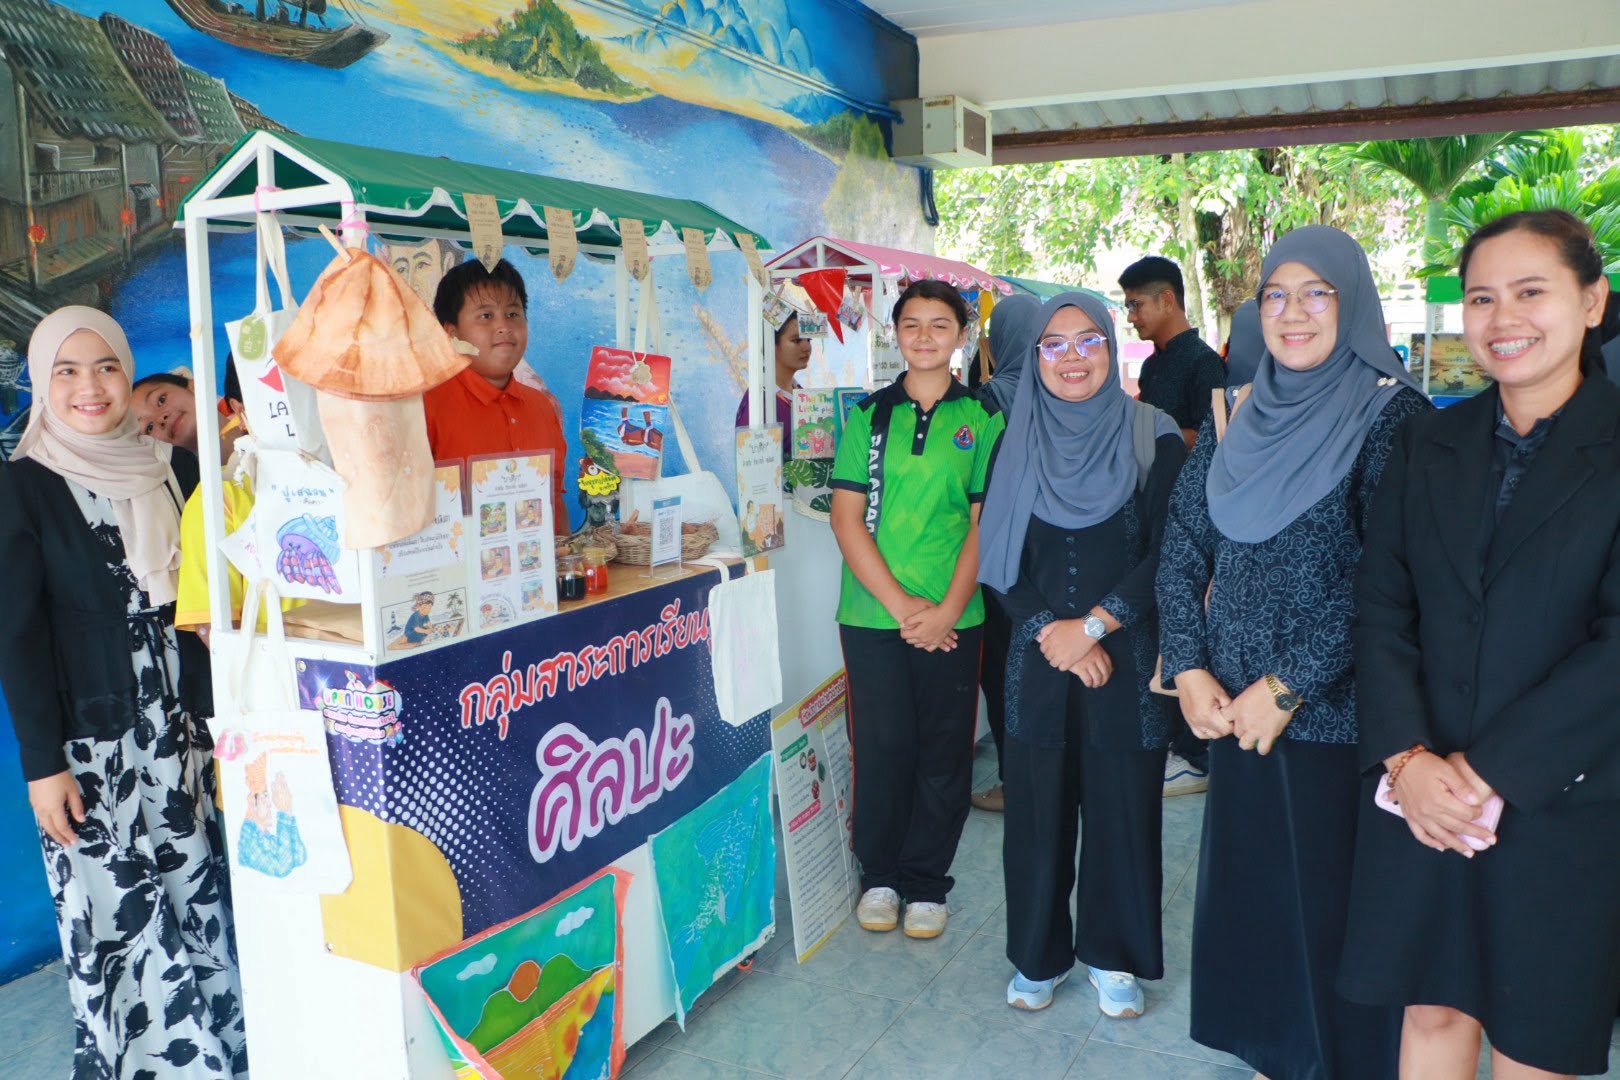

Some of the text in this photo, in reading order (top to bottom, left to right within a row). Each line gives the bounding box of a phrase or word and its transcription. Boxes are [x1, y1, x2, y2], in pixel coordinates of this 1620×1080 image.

[355, 693, 393, 711] HOUSE
[458, 596, 713, 741] กลุ่มสาระการเรียน
[527, 696, 695, 864] ศิลปะ
